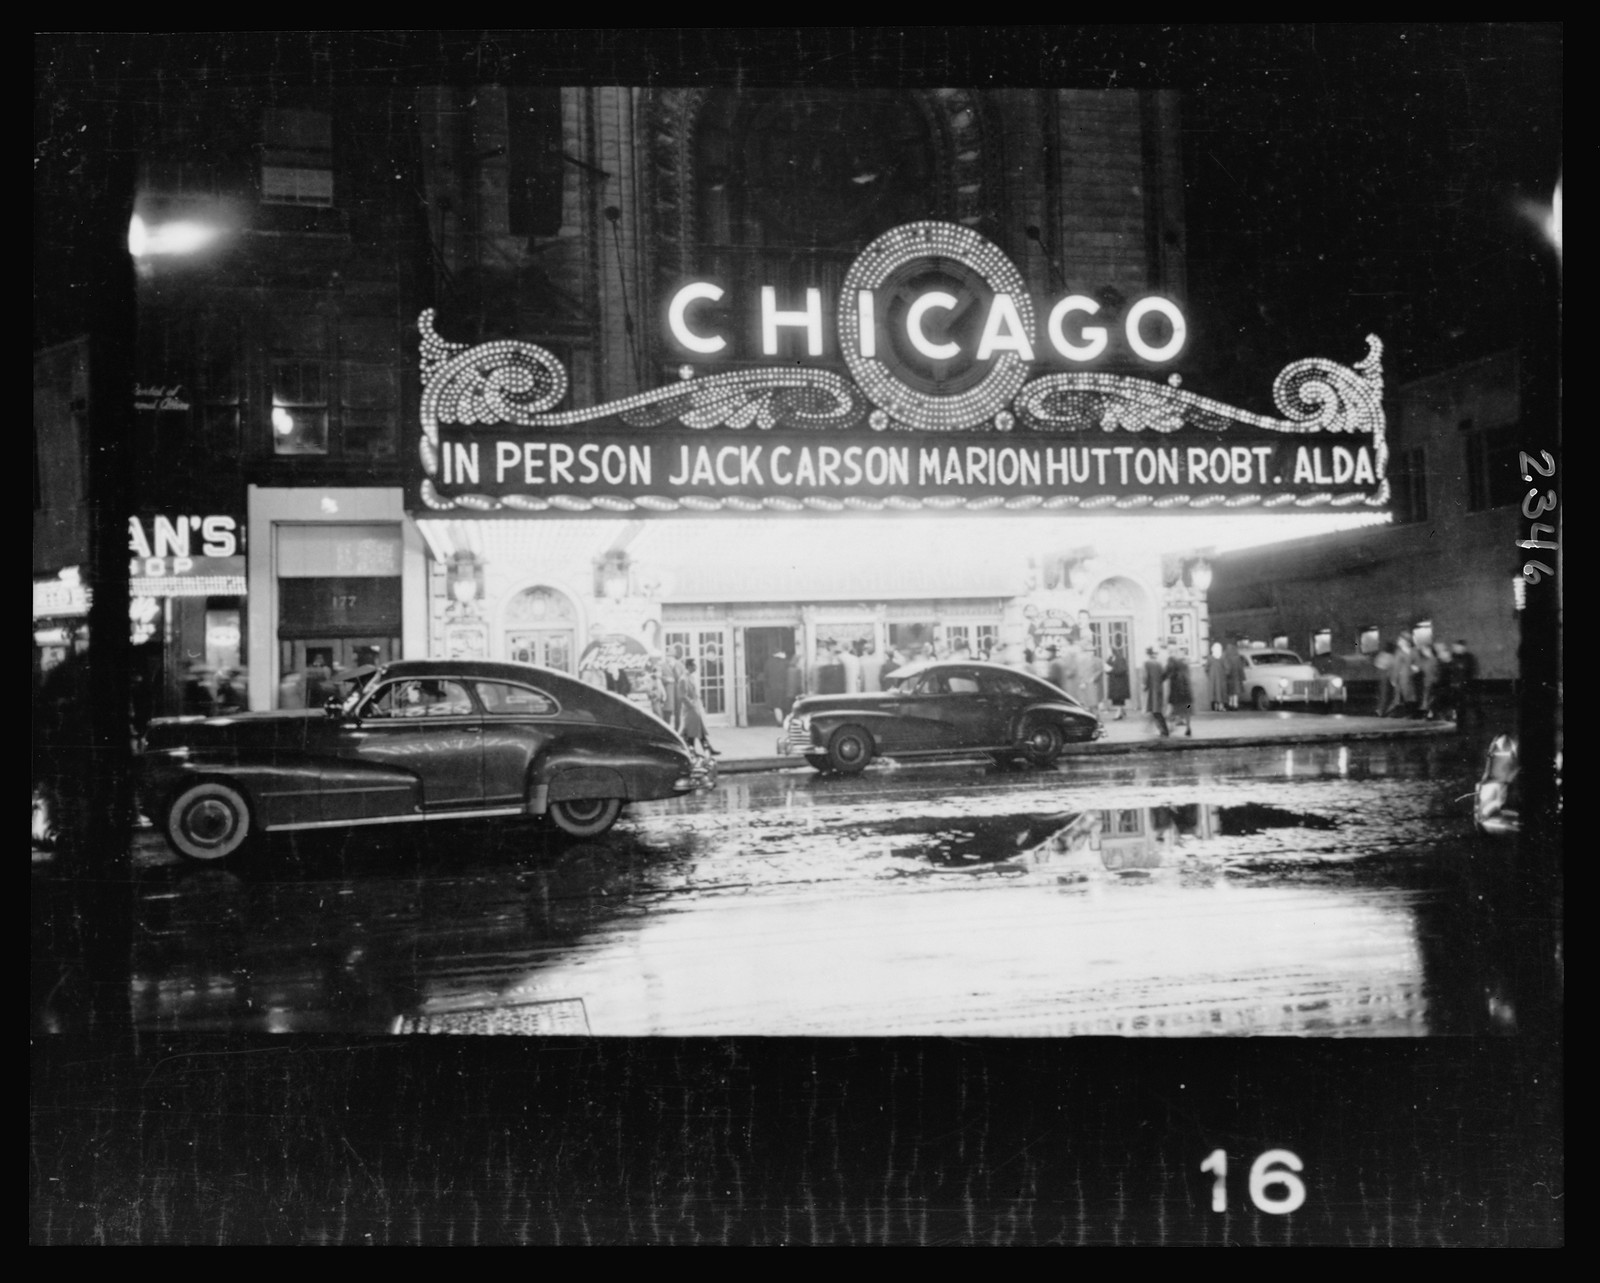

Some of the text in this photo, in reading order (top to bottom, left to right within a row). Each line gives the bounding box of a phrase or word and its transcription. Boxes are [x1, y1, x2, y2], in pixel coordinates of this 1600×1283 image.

[668, 281, 1188, 362] CHICAGO
[442, 441, 1377, 486] IN PERSON JACK CARSON MARION HUTTON ROBT. ALDA
[1200, 1148, 1306, 1215] 16
